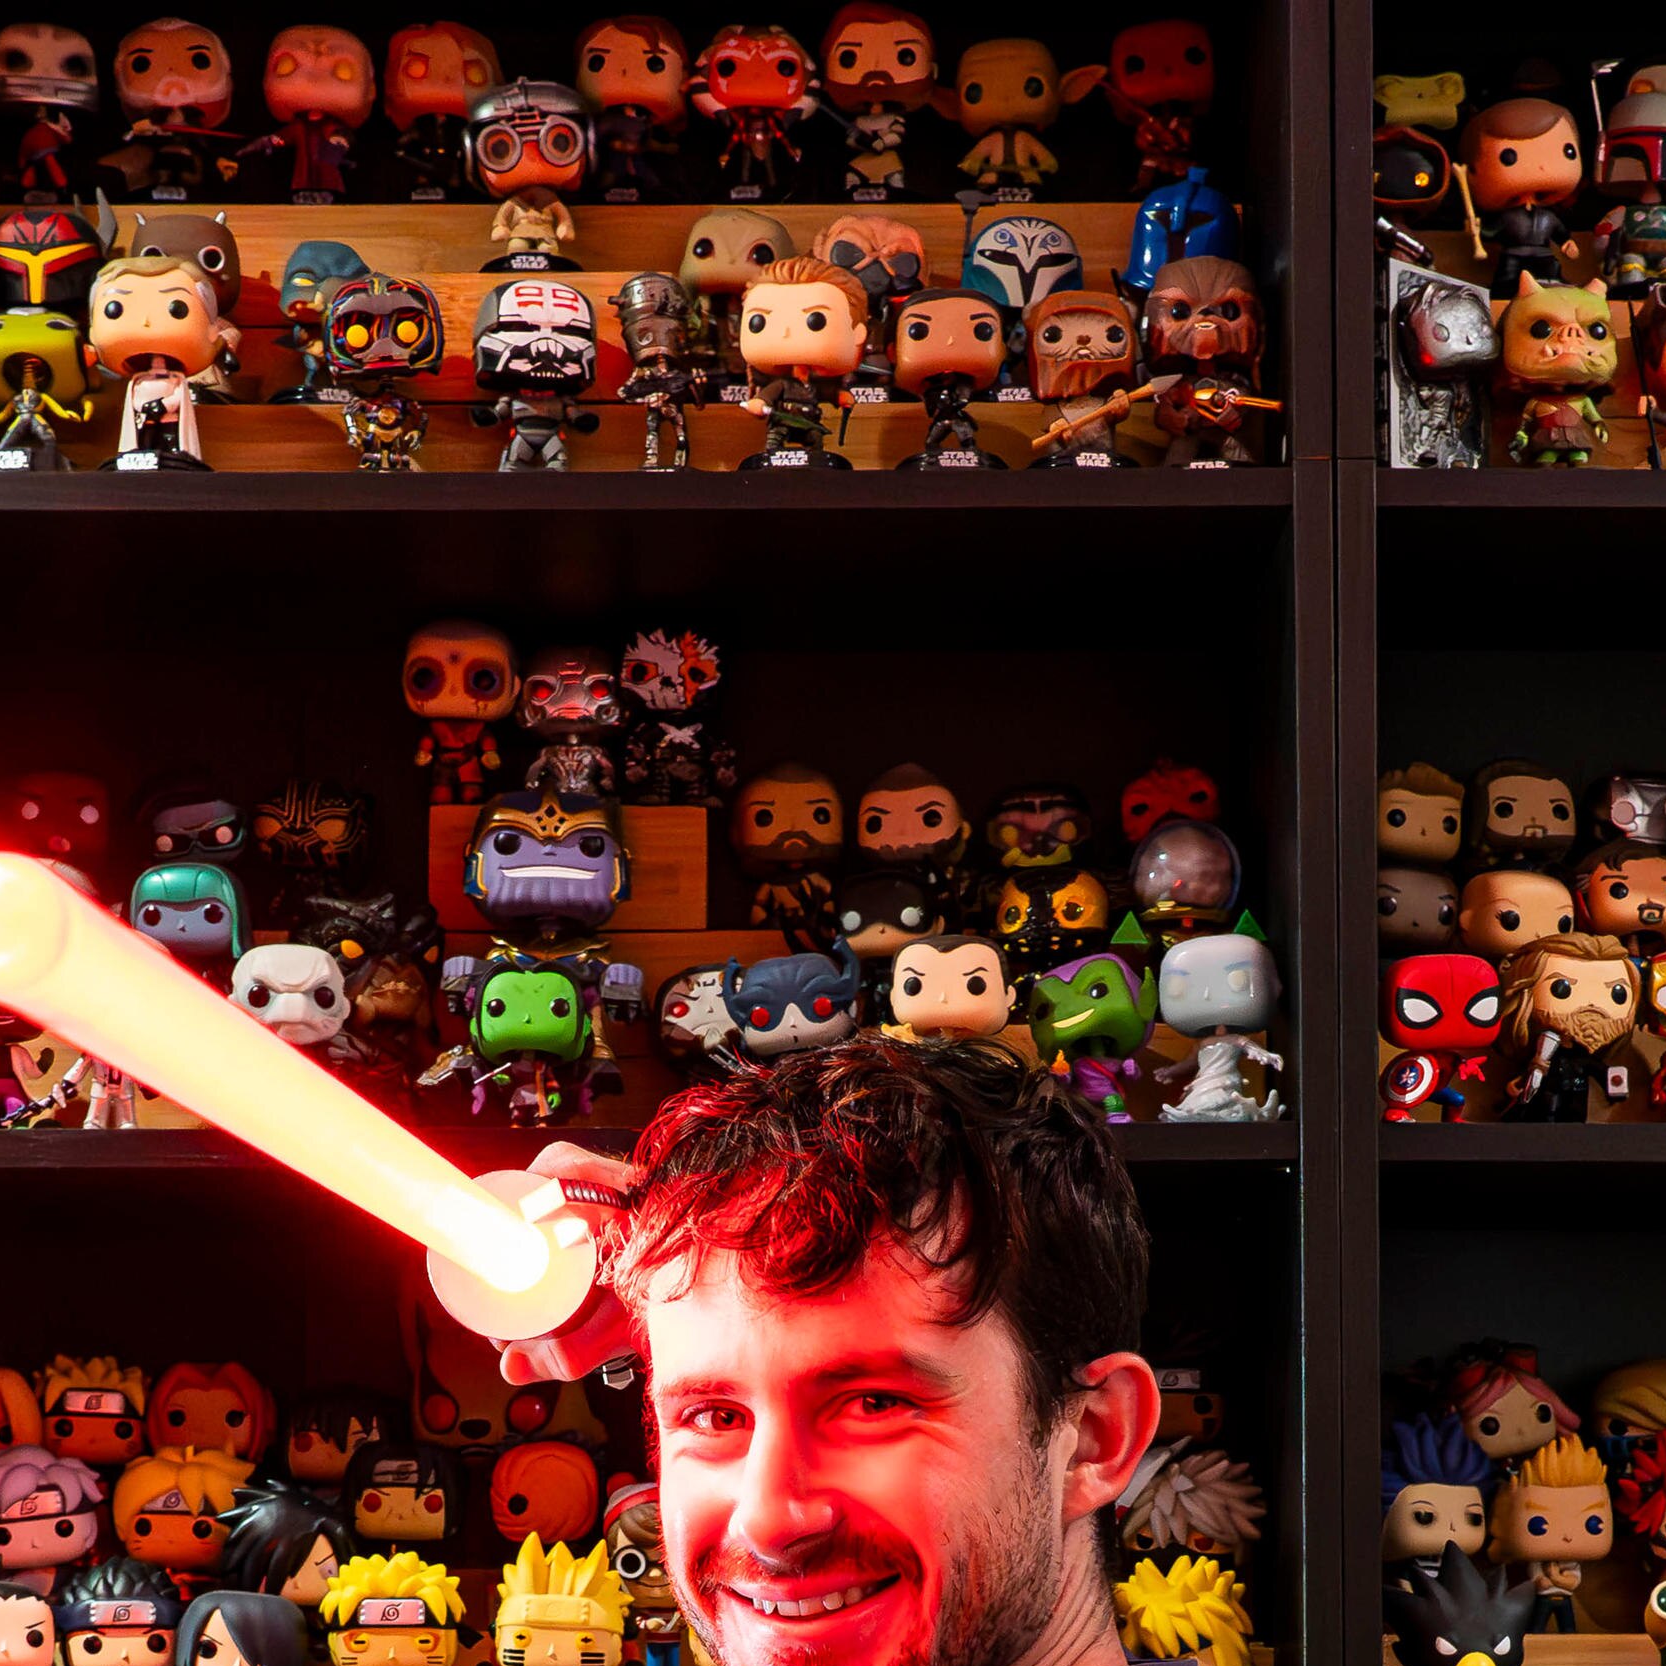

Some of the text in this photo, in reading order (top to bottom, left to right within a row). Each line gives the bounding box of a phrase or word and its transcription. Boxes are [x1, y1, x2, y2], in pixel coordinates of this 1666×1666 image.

[850, 387, 887, 396] STAR
[770, 451, 808, 459] STAR
[937, 451, 979, 459] STAR
[1075, 452, 1110, 460] STAR
[771, 458, 810, 466] WARS
[939, 458, 980, 467] WARS
[1076, 459, 1112, 467] WARS
